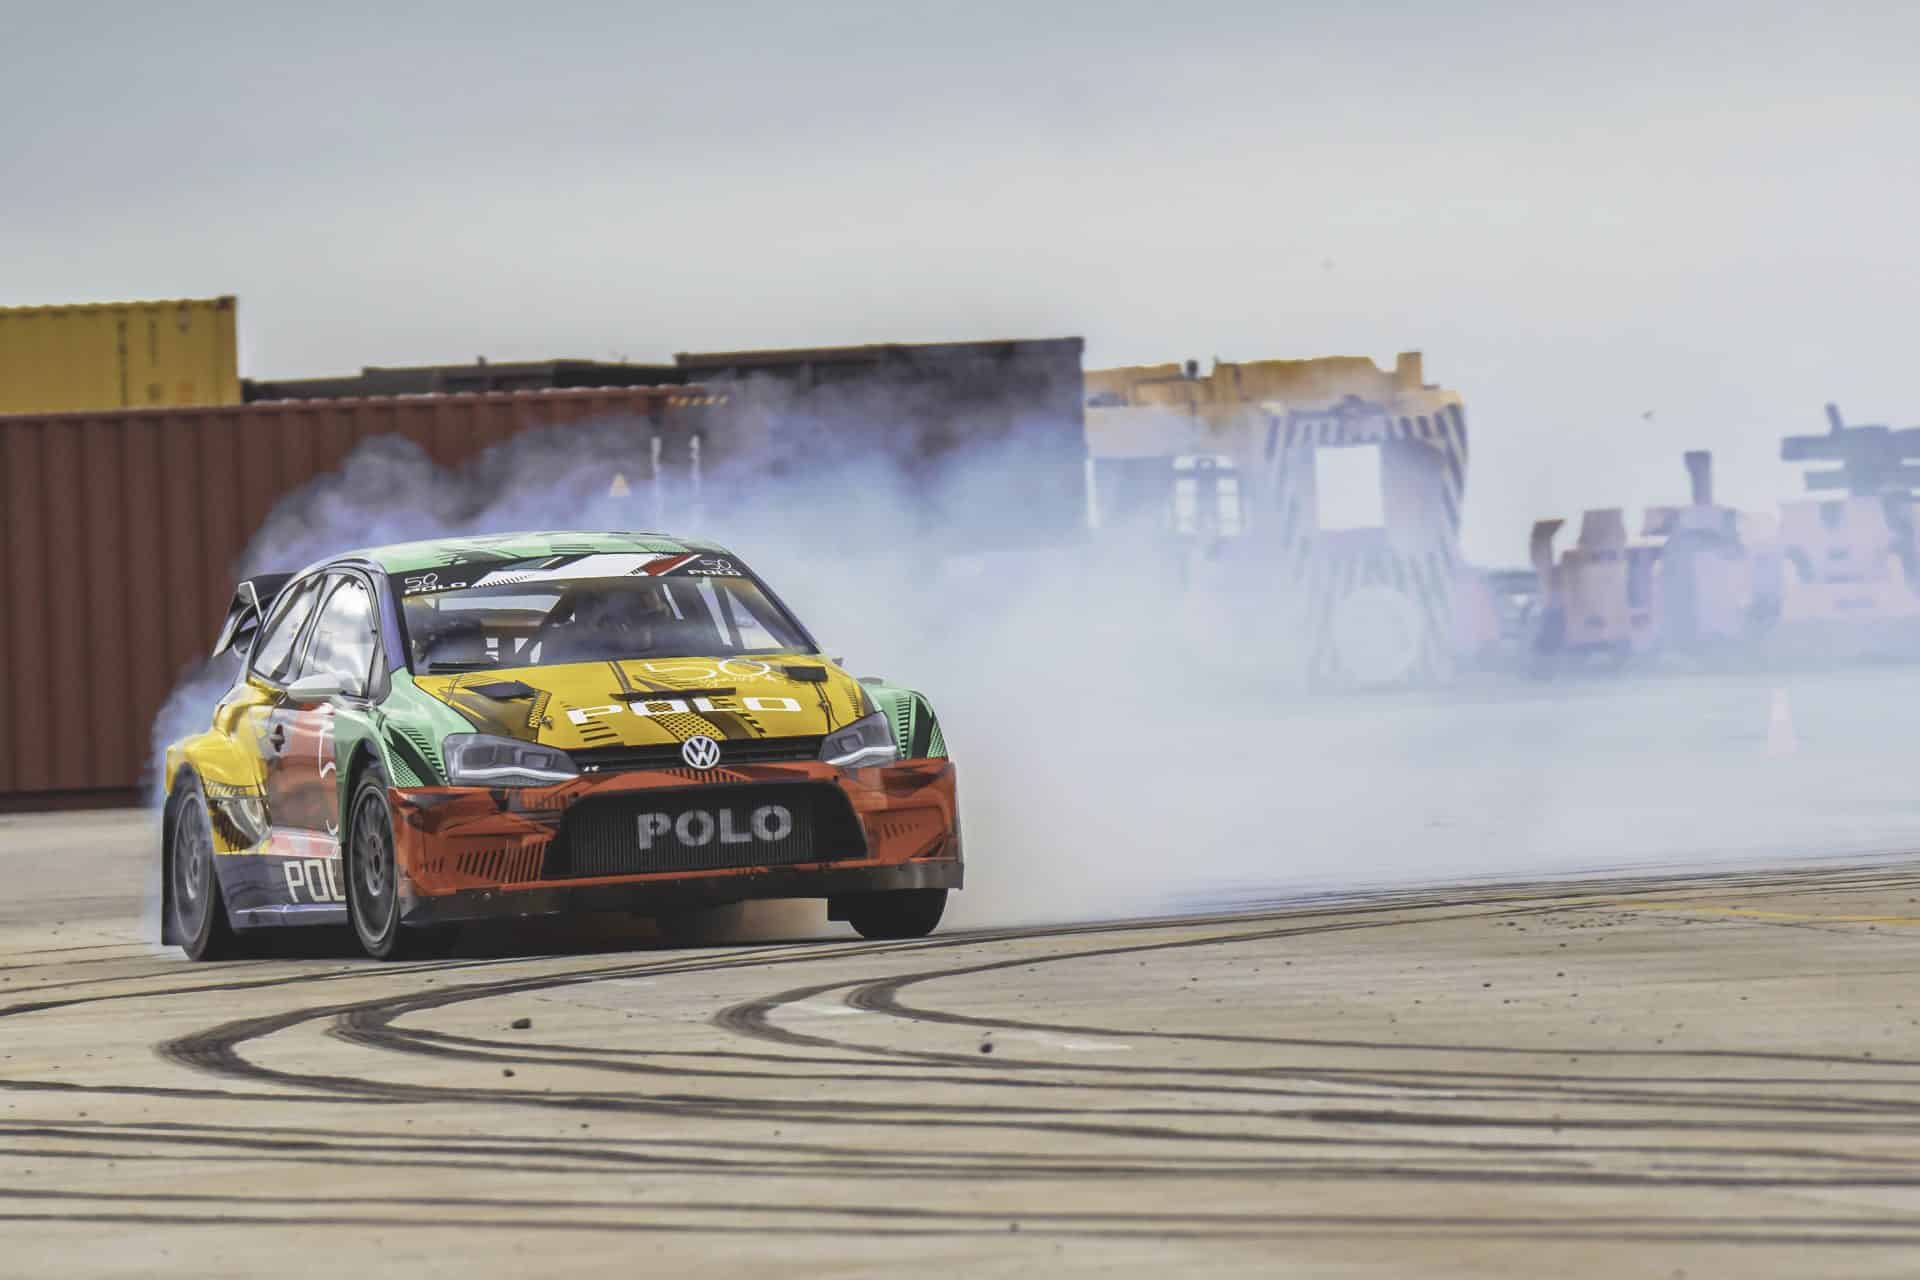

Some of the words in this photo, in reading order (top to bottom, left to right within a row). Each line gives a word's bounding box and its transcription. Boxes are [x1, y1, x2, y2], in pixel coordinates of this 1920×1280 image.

[404, 572, 439, 588] 50
[404, 582, 467, 595] POLO
[642, 658, 771, 681] 50
[567, 697, 802, 725] POLO
[682, 735, 720, 769] VW
[637, 805, 793, 850] POLO
